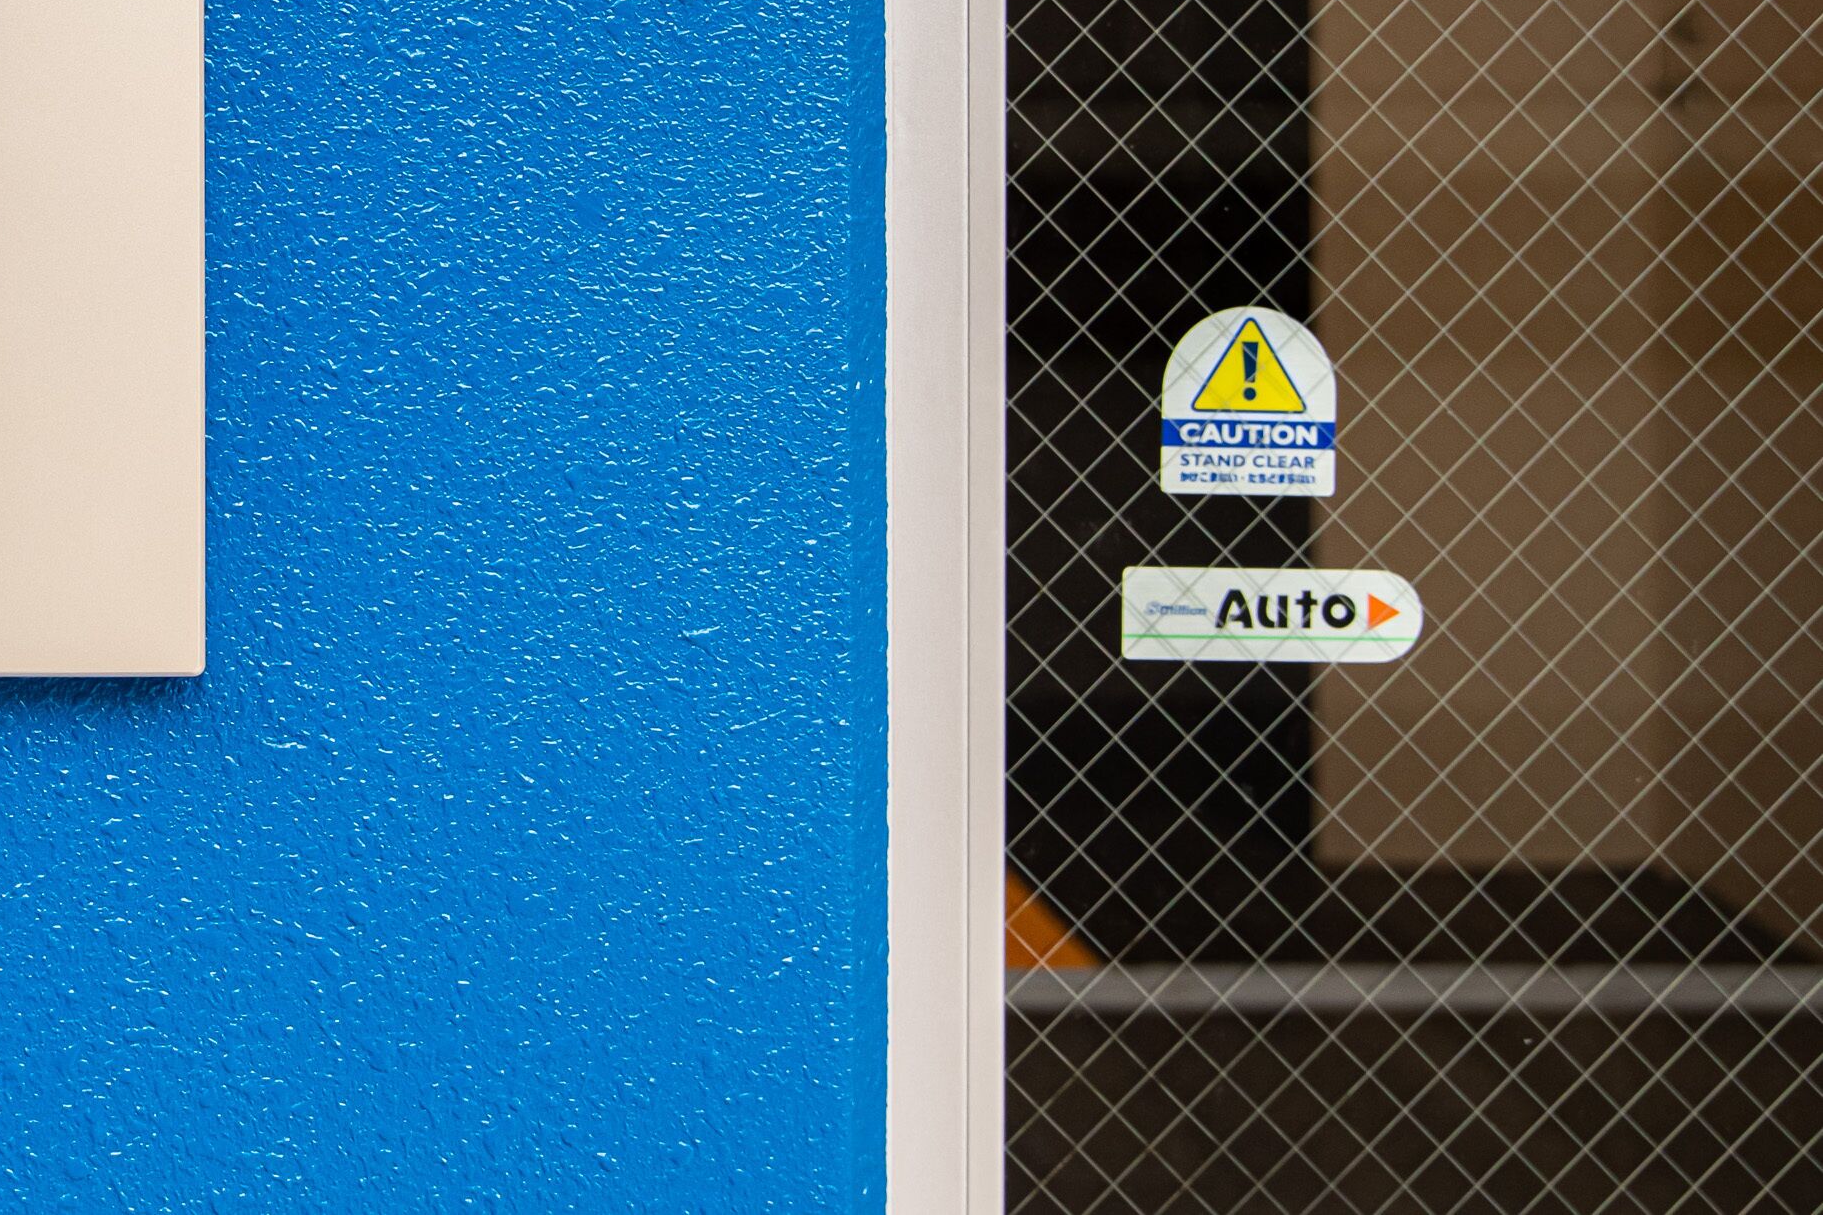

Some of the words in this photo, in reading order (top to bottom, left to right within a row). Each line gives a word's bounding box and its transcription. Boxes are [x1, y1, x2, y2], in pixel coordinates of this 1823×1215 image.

[1179, 423, 1318, 446] CAUTION
[1180, 453, 1246, 467] STAND
[1252, 454, 1315, 468] CLEAR
[1215, 588, 1356, 629] Auto
